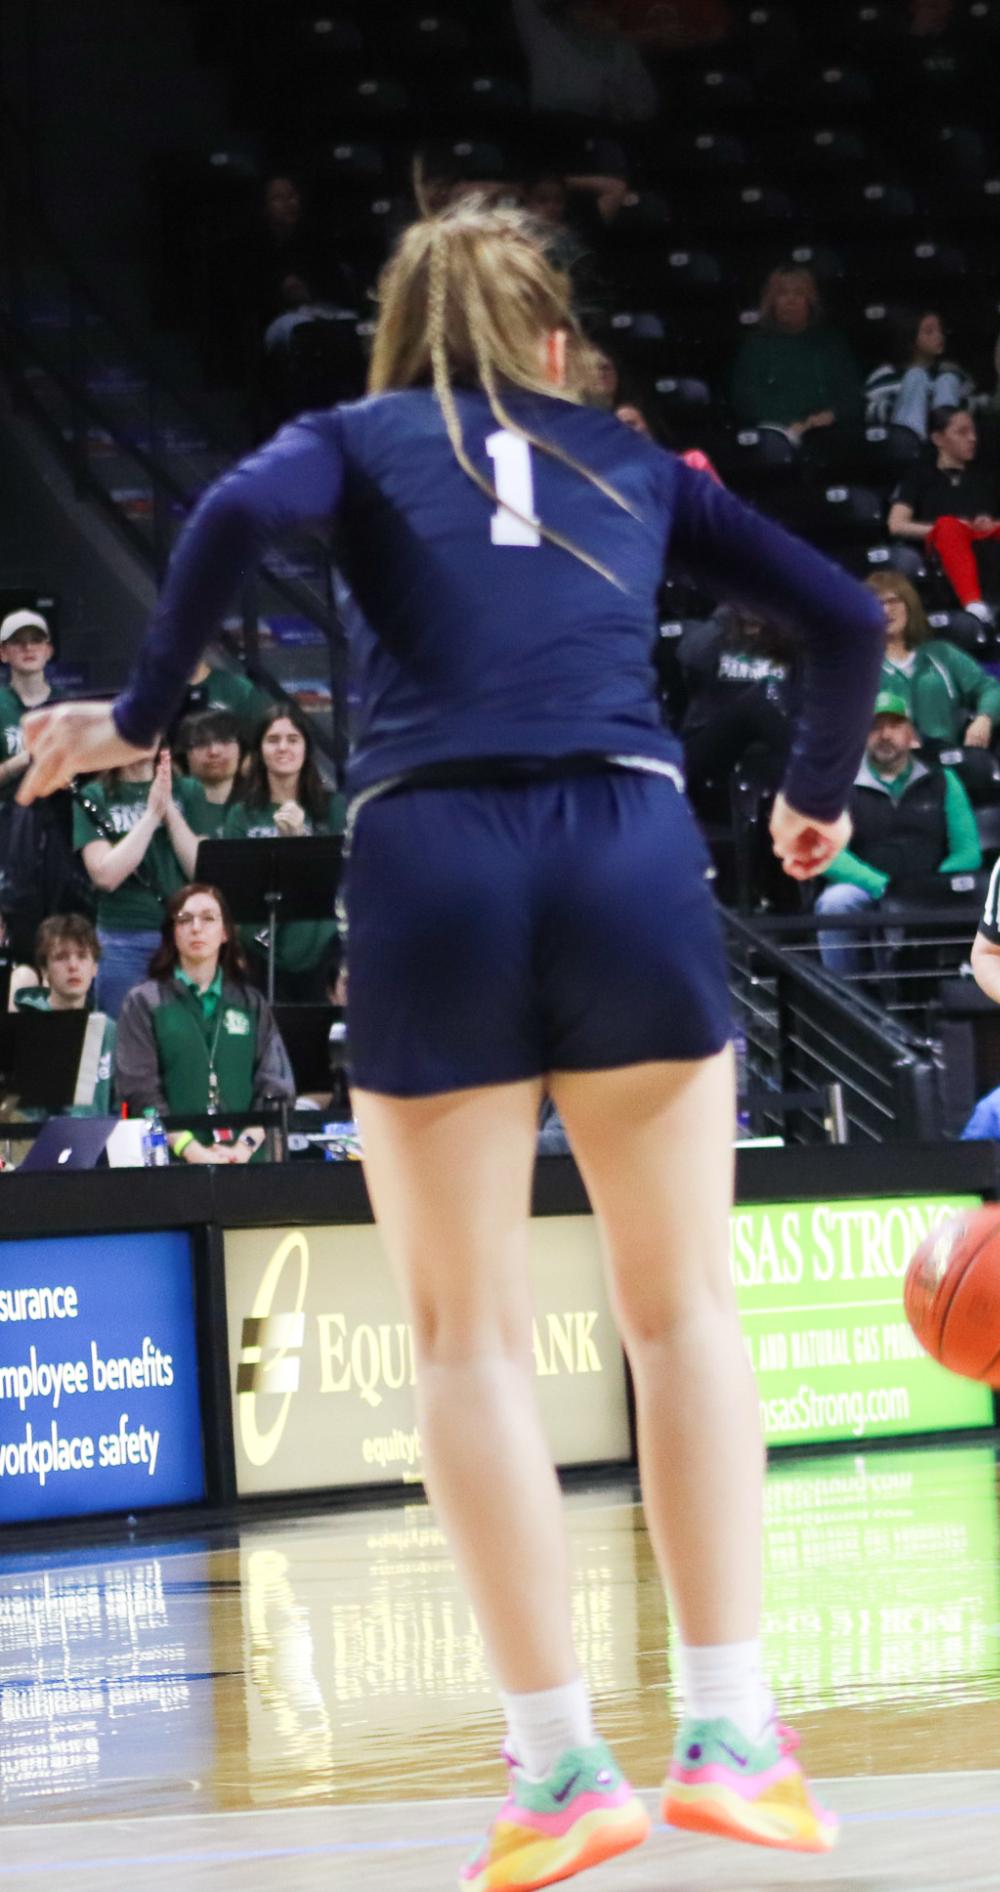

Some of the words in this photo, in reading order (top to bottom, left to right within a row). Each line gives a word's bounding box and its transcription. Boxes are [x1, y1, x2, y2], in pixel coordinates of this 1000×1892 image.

[485, 430, 541, 547] 1
[811, 1206, 957, 1281] STRON
[91, 1336, 174, 1391] benefits
[790, 1328, 851, 1369] NATURAL
[853, 1325, 880, 1364] GAS
[98, 1413, 160, 1475] safety
